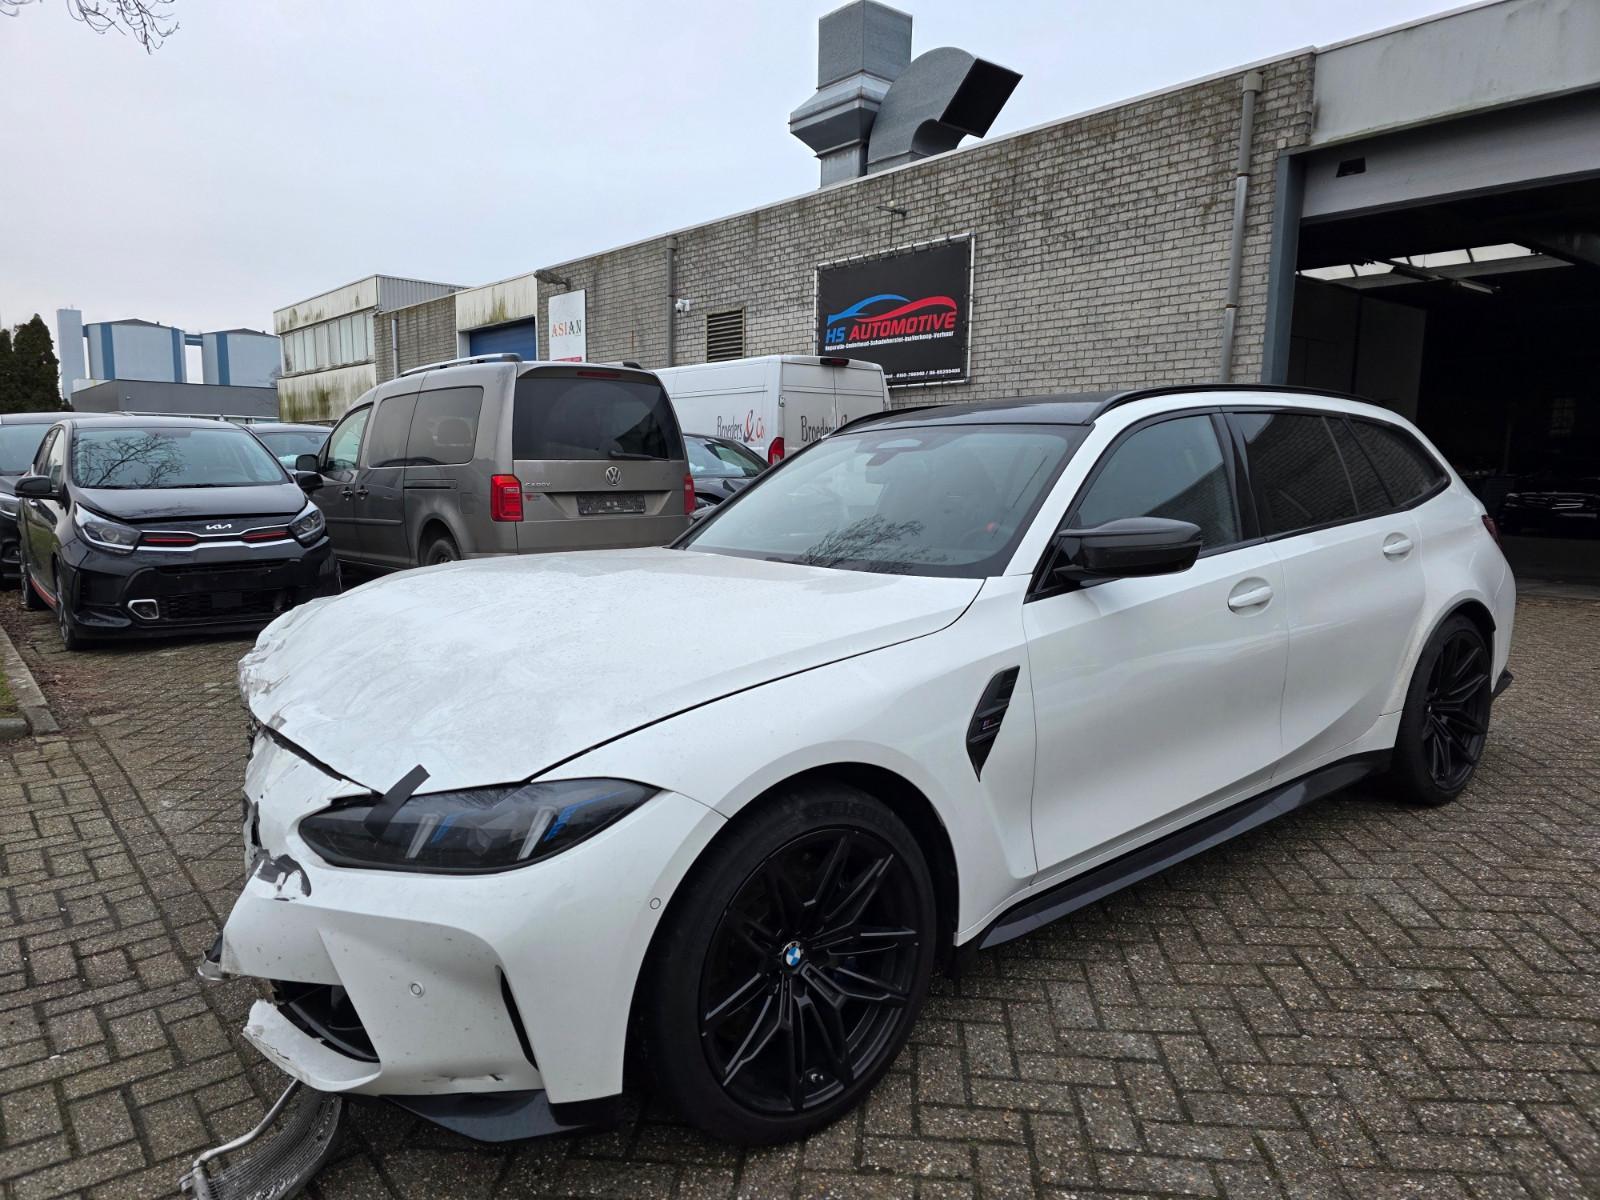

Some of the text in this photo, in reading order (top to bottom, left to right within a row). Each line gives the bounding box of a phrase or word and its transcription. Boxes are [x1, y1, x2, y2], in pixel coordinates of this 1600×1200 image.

[551, 320, 581, 337] ASIAN
[825, 311, 957, 344] HS AUTOMOTIVE
[717, 415, 743, 441] Broeders
[800, 415, 835, 442] Broede
